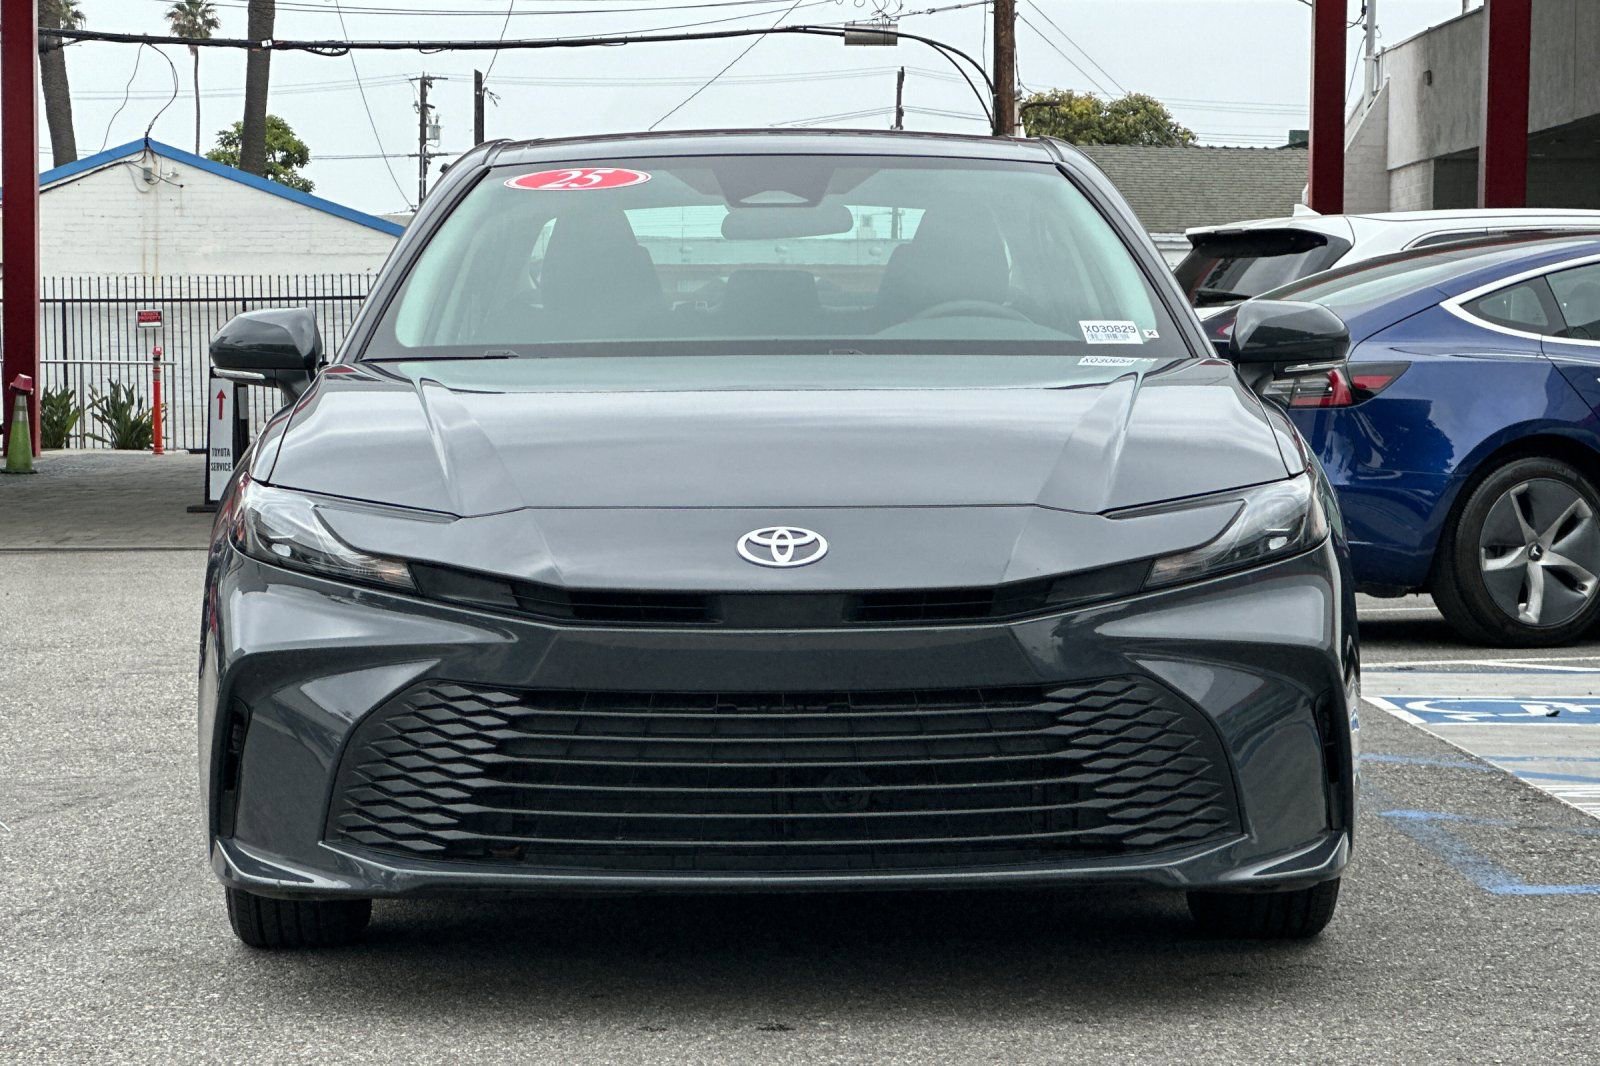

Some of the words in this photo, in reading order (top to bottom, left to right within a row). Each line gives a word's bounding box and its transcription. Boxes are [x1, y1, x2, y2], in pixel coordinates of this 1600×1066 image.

[537, 169, 616, 188] 25
[1084, 325, 1136, 333] X030829
[211, 448, 230, 457] TOYOTA
[211, 462, 231, 471] SERVICE
